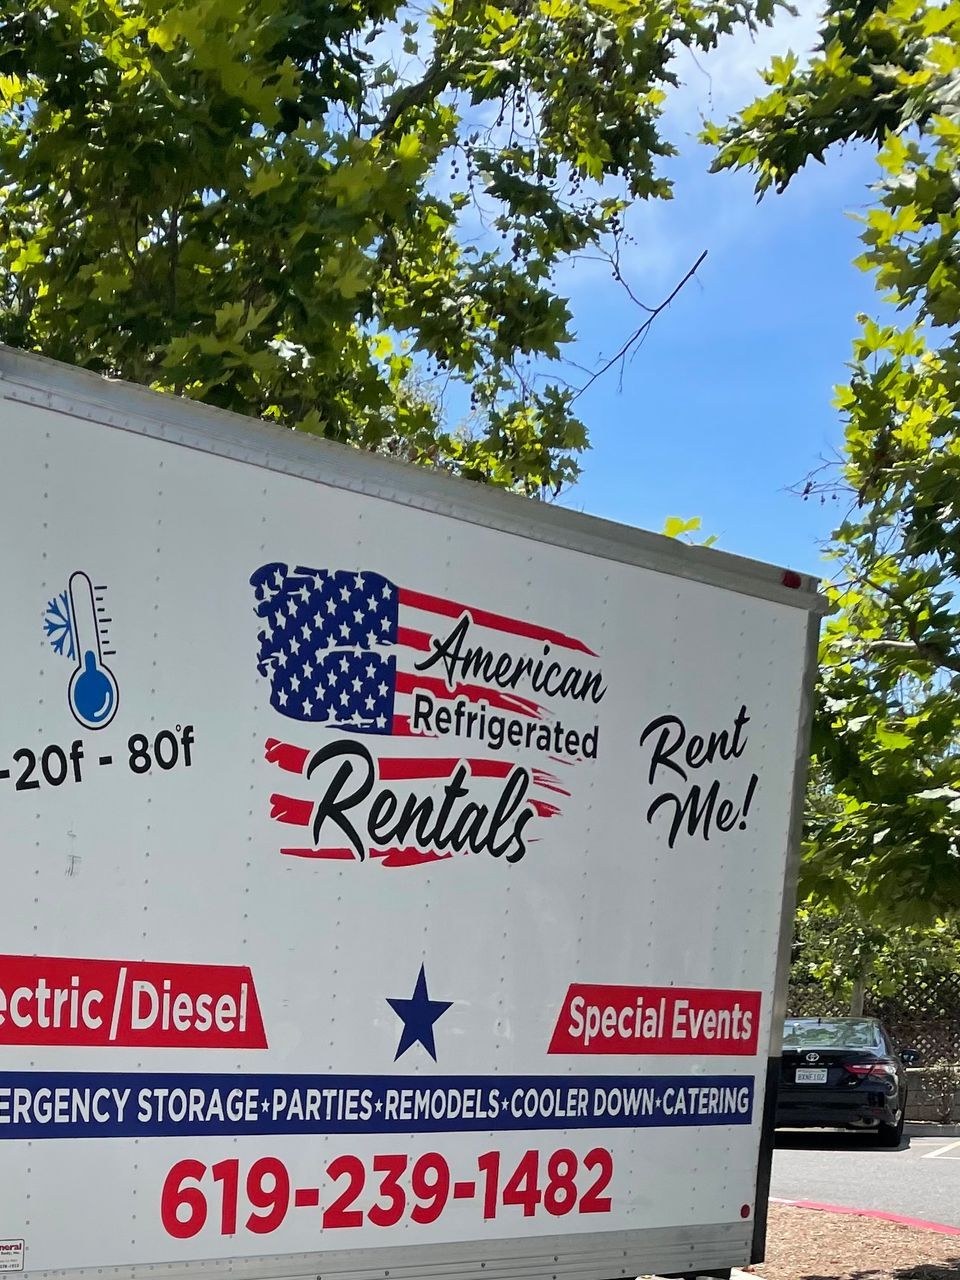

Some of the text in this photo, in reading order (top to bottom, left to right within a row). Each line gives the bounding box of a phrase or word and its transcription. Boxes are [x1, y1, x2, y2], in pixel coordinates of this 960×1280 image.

[414, 616, 608, 704] American
[413, 693, 600, 760] Refrigerated
[640, 704, 752, 786] Rent
[306, 739, 537, 864] Rentals
[647, 774, 759, 849] Me!
[567, 996, 753, 1046] Special Events
[138, 1088, 259, 1122] STORAGE
[273, 1088, 373, 1121] PARTIES
[385, 1088, 499, 1120] REMODELS
[510, 1087, 588, 1119] COOLER
[593, 1087, 655, 1118] DOWN
[662, 1086, 750, 1116] CATERING
[160, 1147, 614, 1239] 619-239-1482
